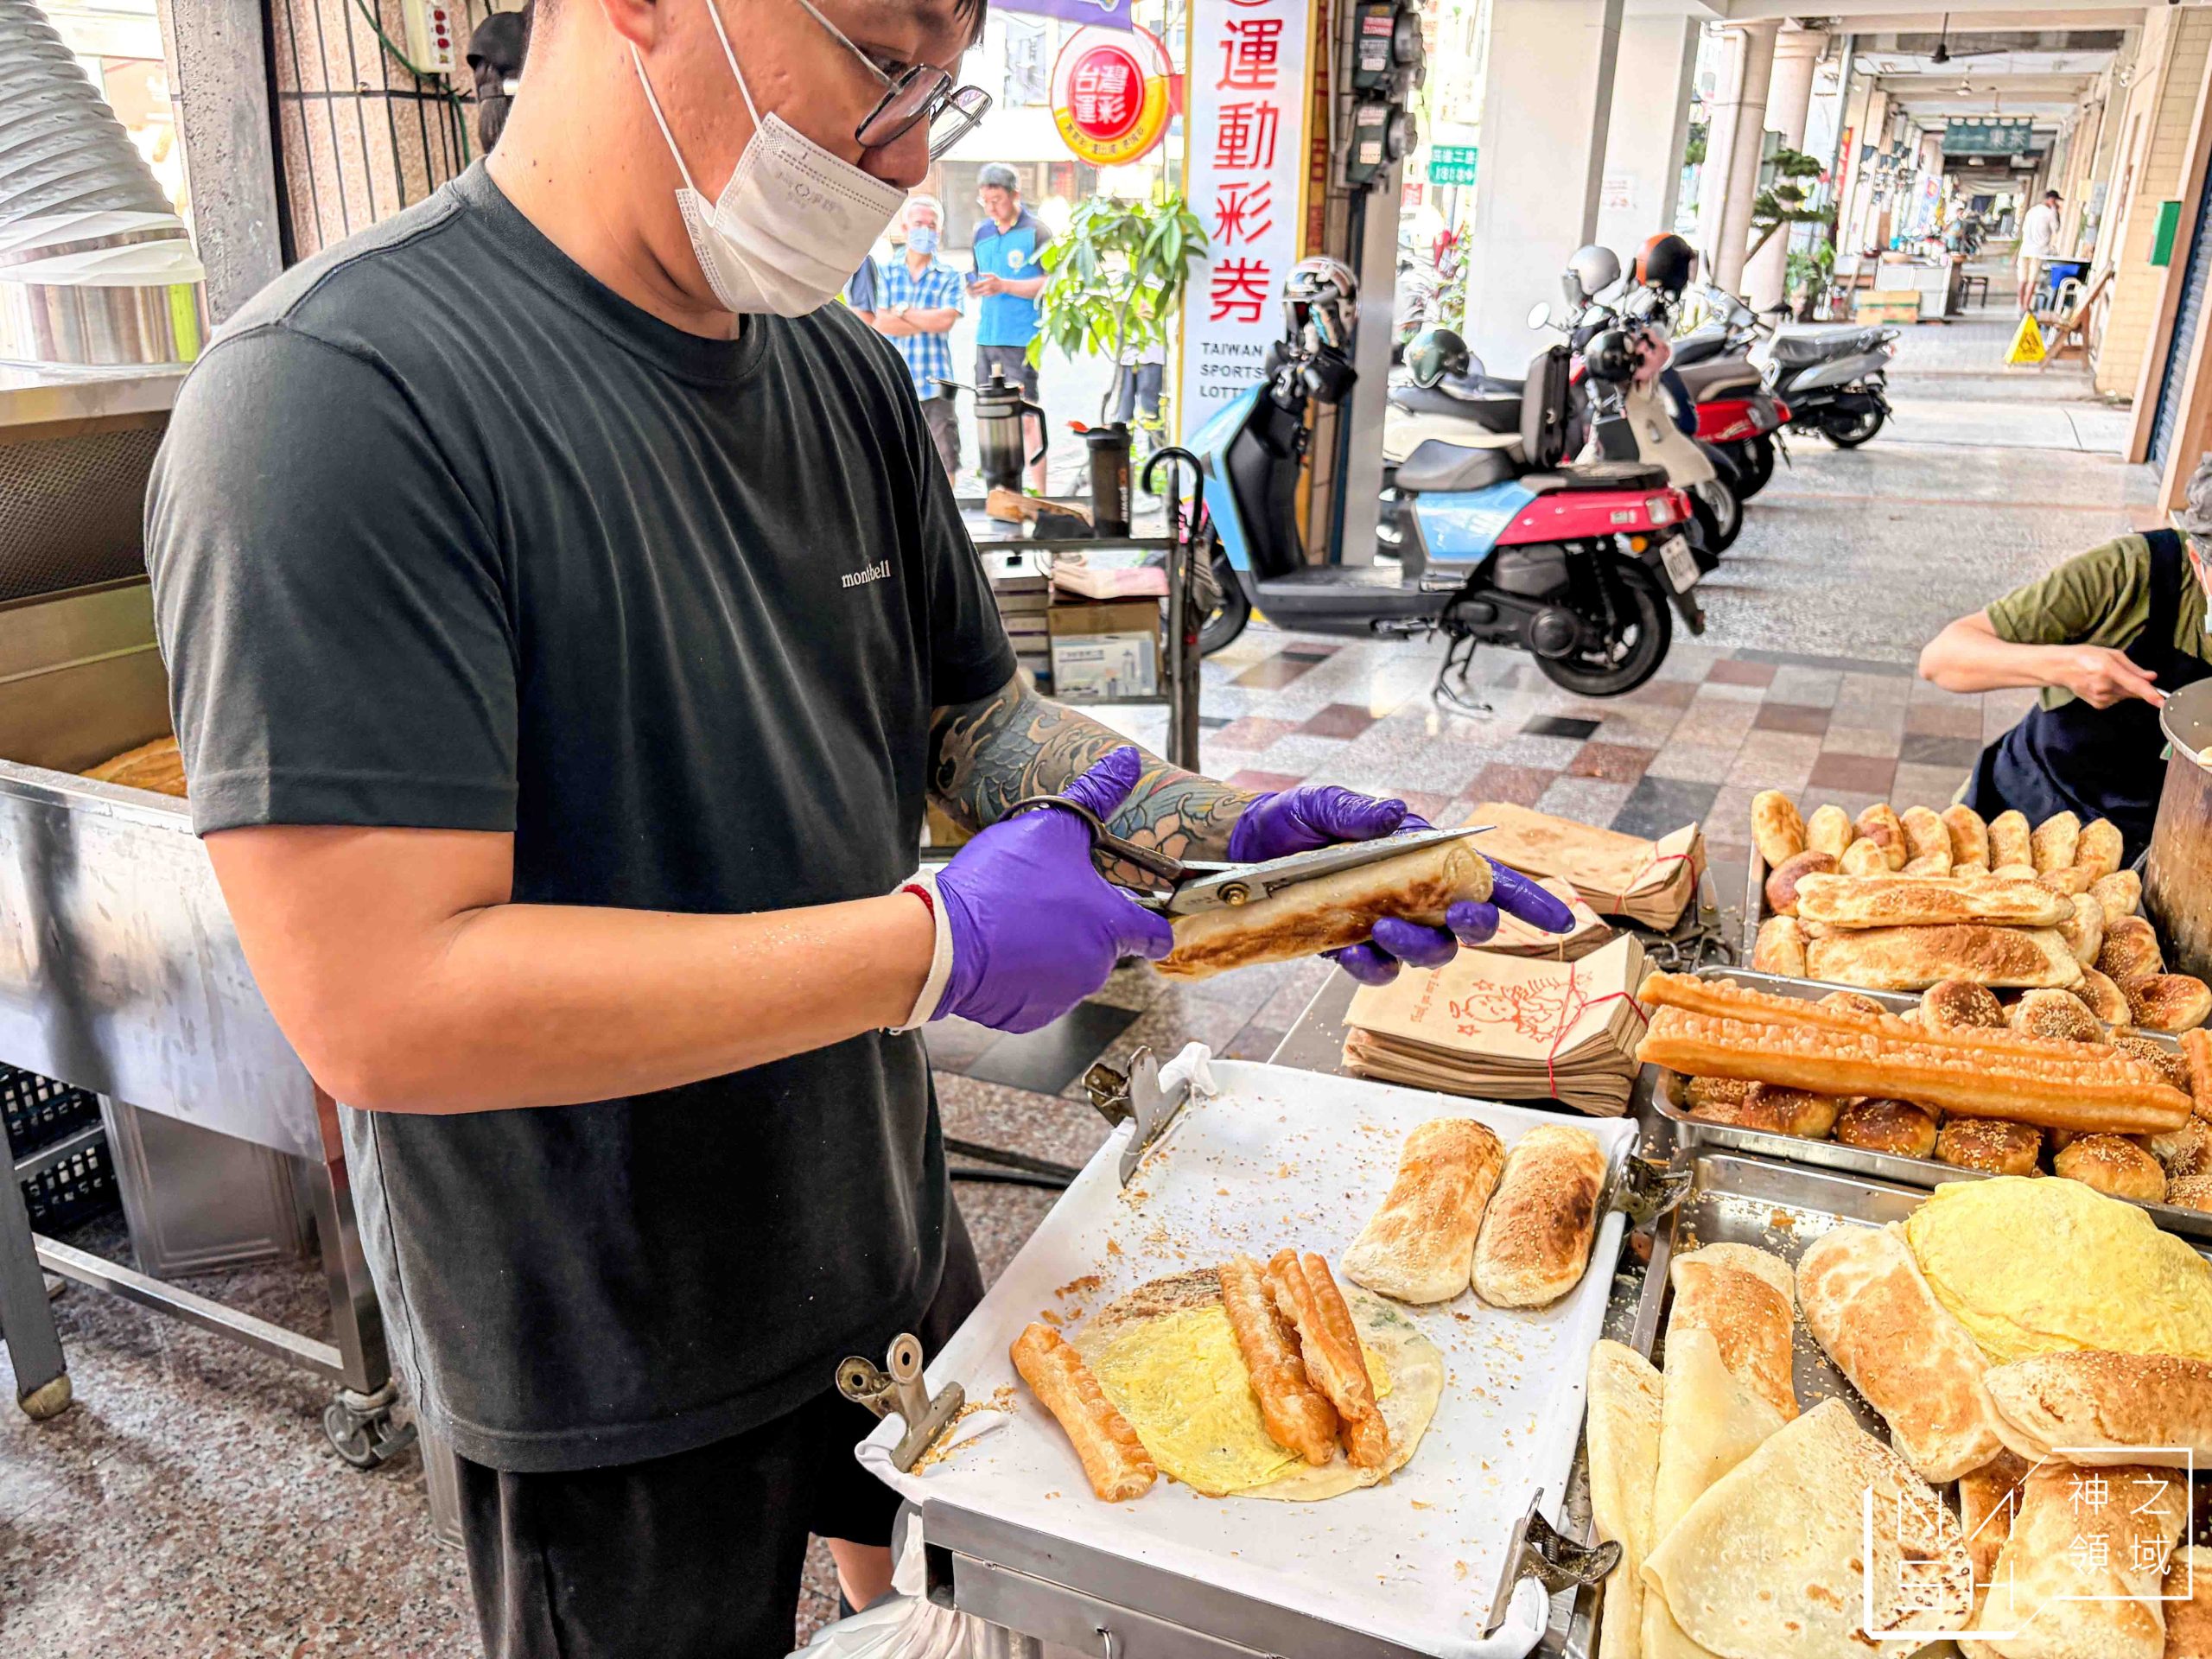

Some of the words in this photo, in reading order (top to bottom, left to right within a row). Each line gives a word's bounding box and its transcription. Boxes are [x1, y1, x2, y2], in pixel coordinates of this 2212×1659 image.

[1076, 63, 1129, 93] 台灣
[1075, 94, 1126, 124] 運彩
[1209, 19, 1283, 323] 運動彩券
[1200, 342, 1263, 356] TAIWAN
[1199, 364, 1265, 378] SPORTS
[1199, 385, 1247, 398] LOTT
[842, 560, 891, 588] montbell
